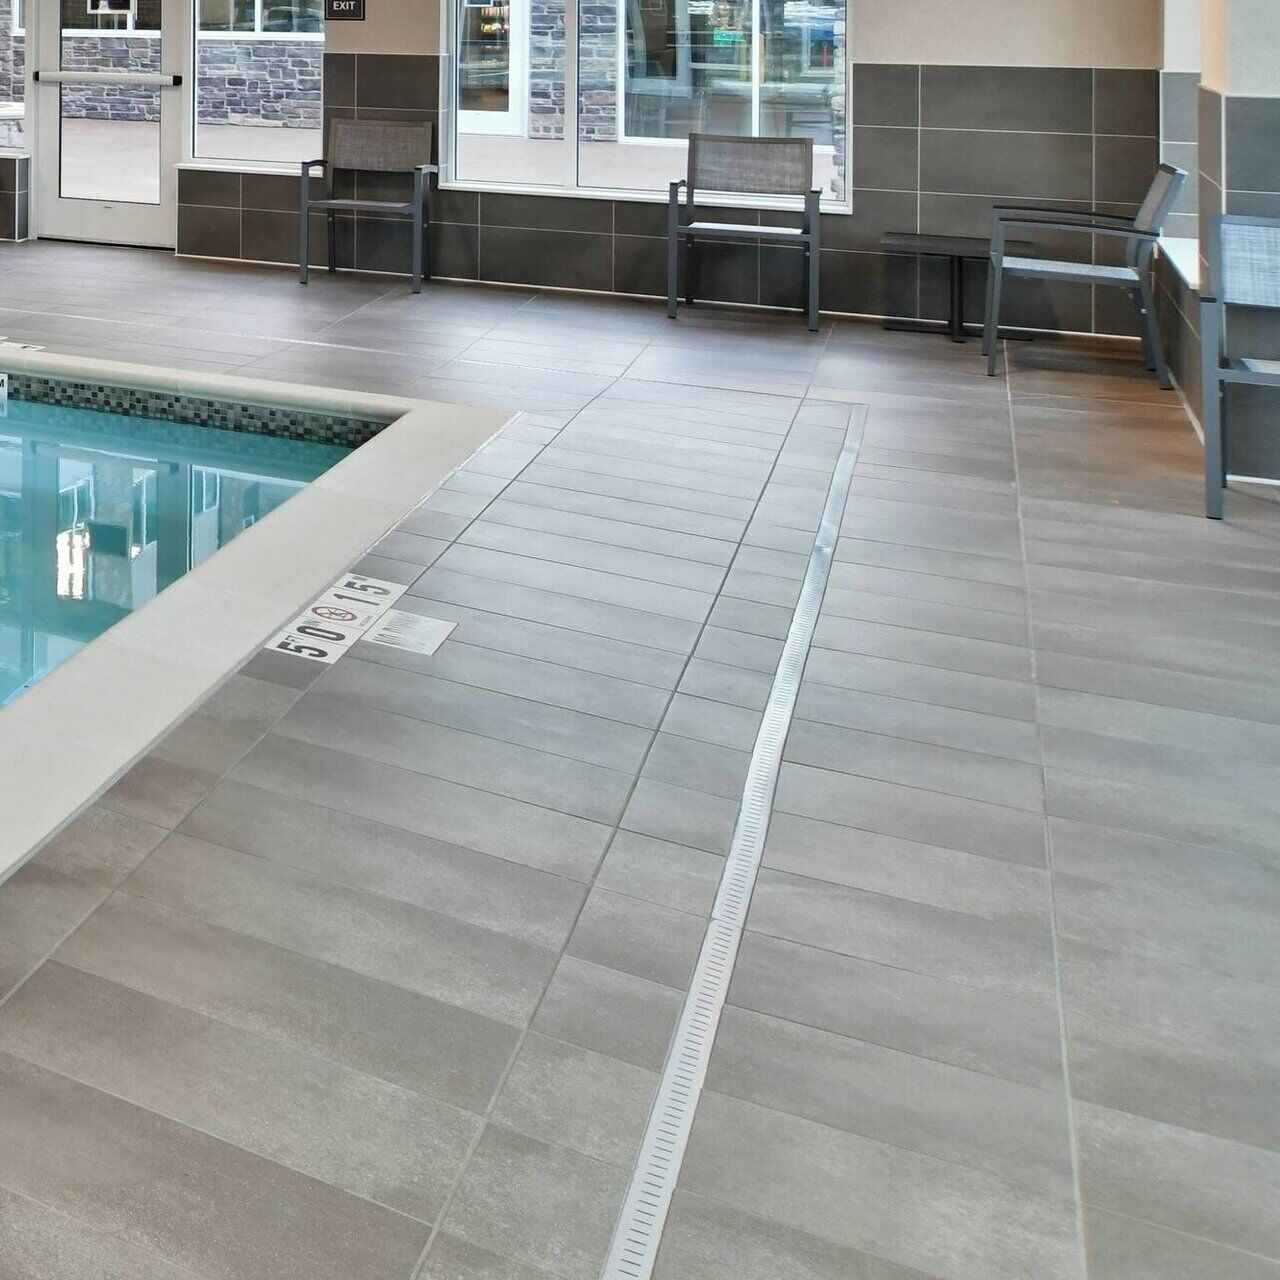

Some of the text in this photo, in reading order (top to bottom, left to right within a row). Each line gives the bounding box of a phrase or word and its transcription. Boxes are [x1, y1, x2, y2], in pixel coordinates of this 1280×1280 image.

[333, 1, 356, 10] EXIT
[296, 625, 346, 642] 0
[276, 640, 328, 658] 5
